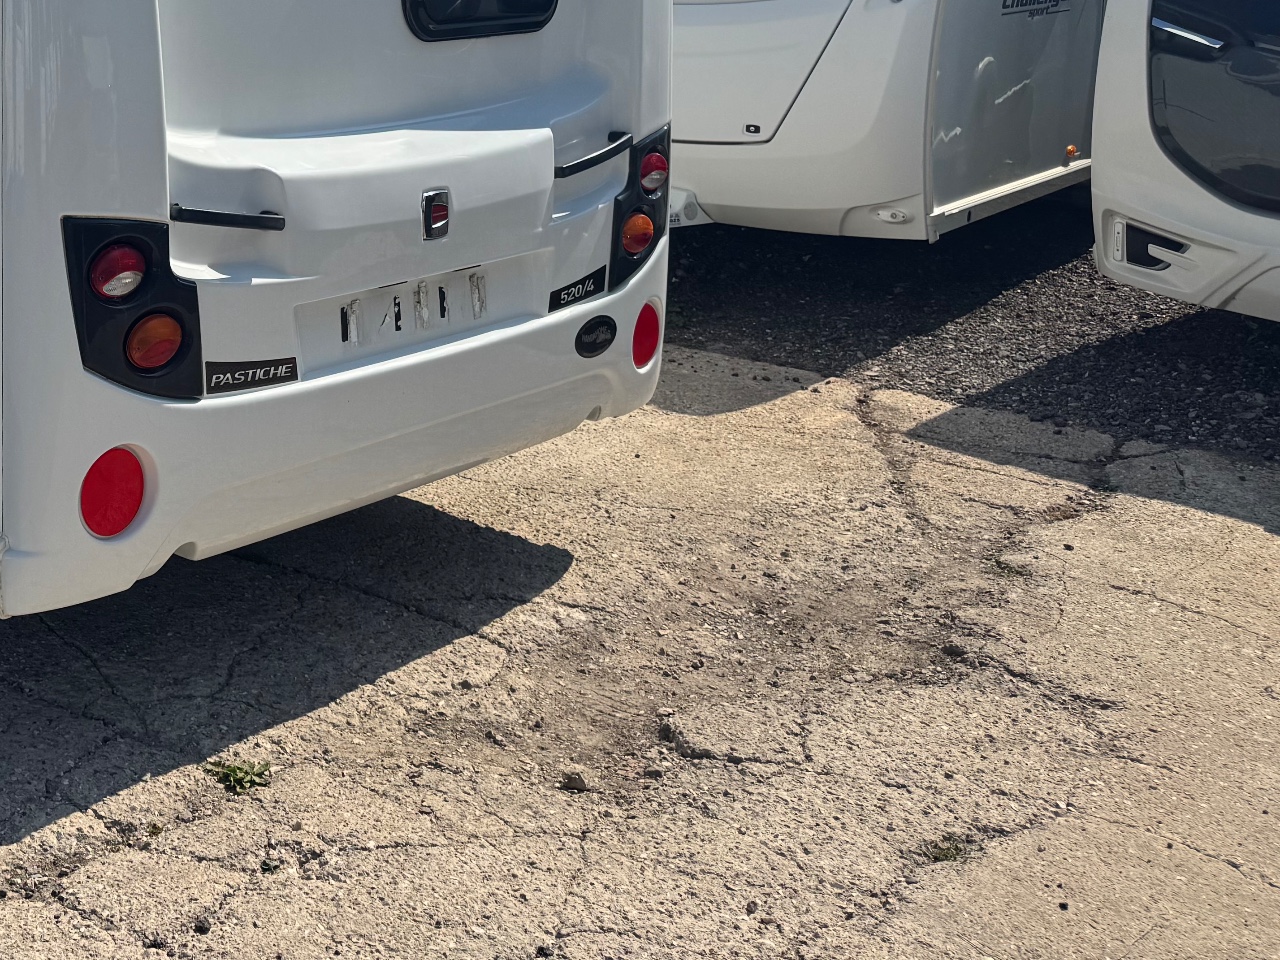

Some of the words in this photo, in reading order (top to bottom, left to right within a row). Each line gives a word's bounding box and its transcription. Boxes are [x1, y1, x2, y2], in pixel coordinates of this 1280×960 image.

[1028, 5, 1050, 19] sport
[560, 279, 595, 304] 520/4
[210, 364, 293, 387] PASTICHE
